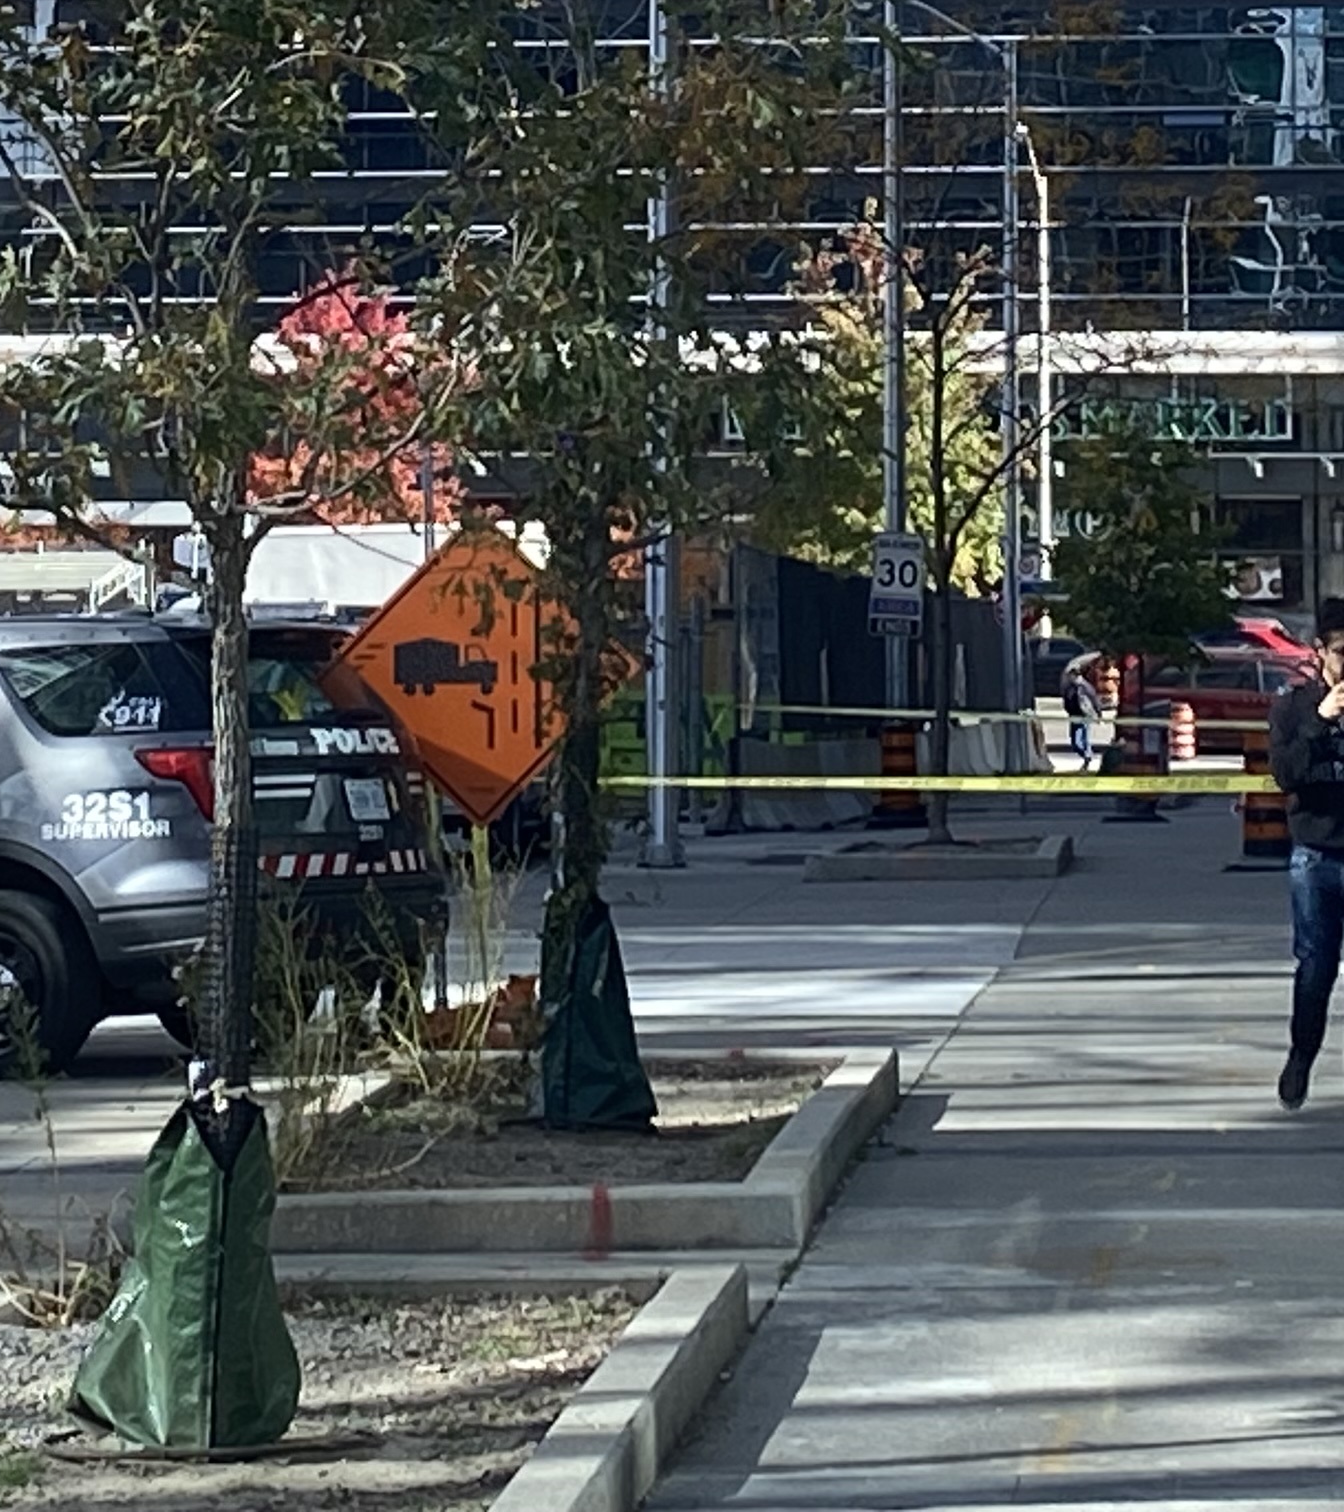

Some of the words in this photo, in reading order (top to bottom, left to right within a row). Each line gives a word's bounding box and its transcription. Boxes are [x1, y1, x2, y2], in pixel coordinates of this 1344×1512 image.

[877, 558, 918, 588] 30
[114, 704, 161, 725] 911
[61, 790, 150, 823] 32S1
[40, 819, 171, 840] SUPERVISOR
